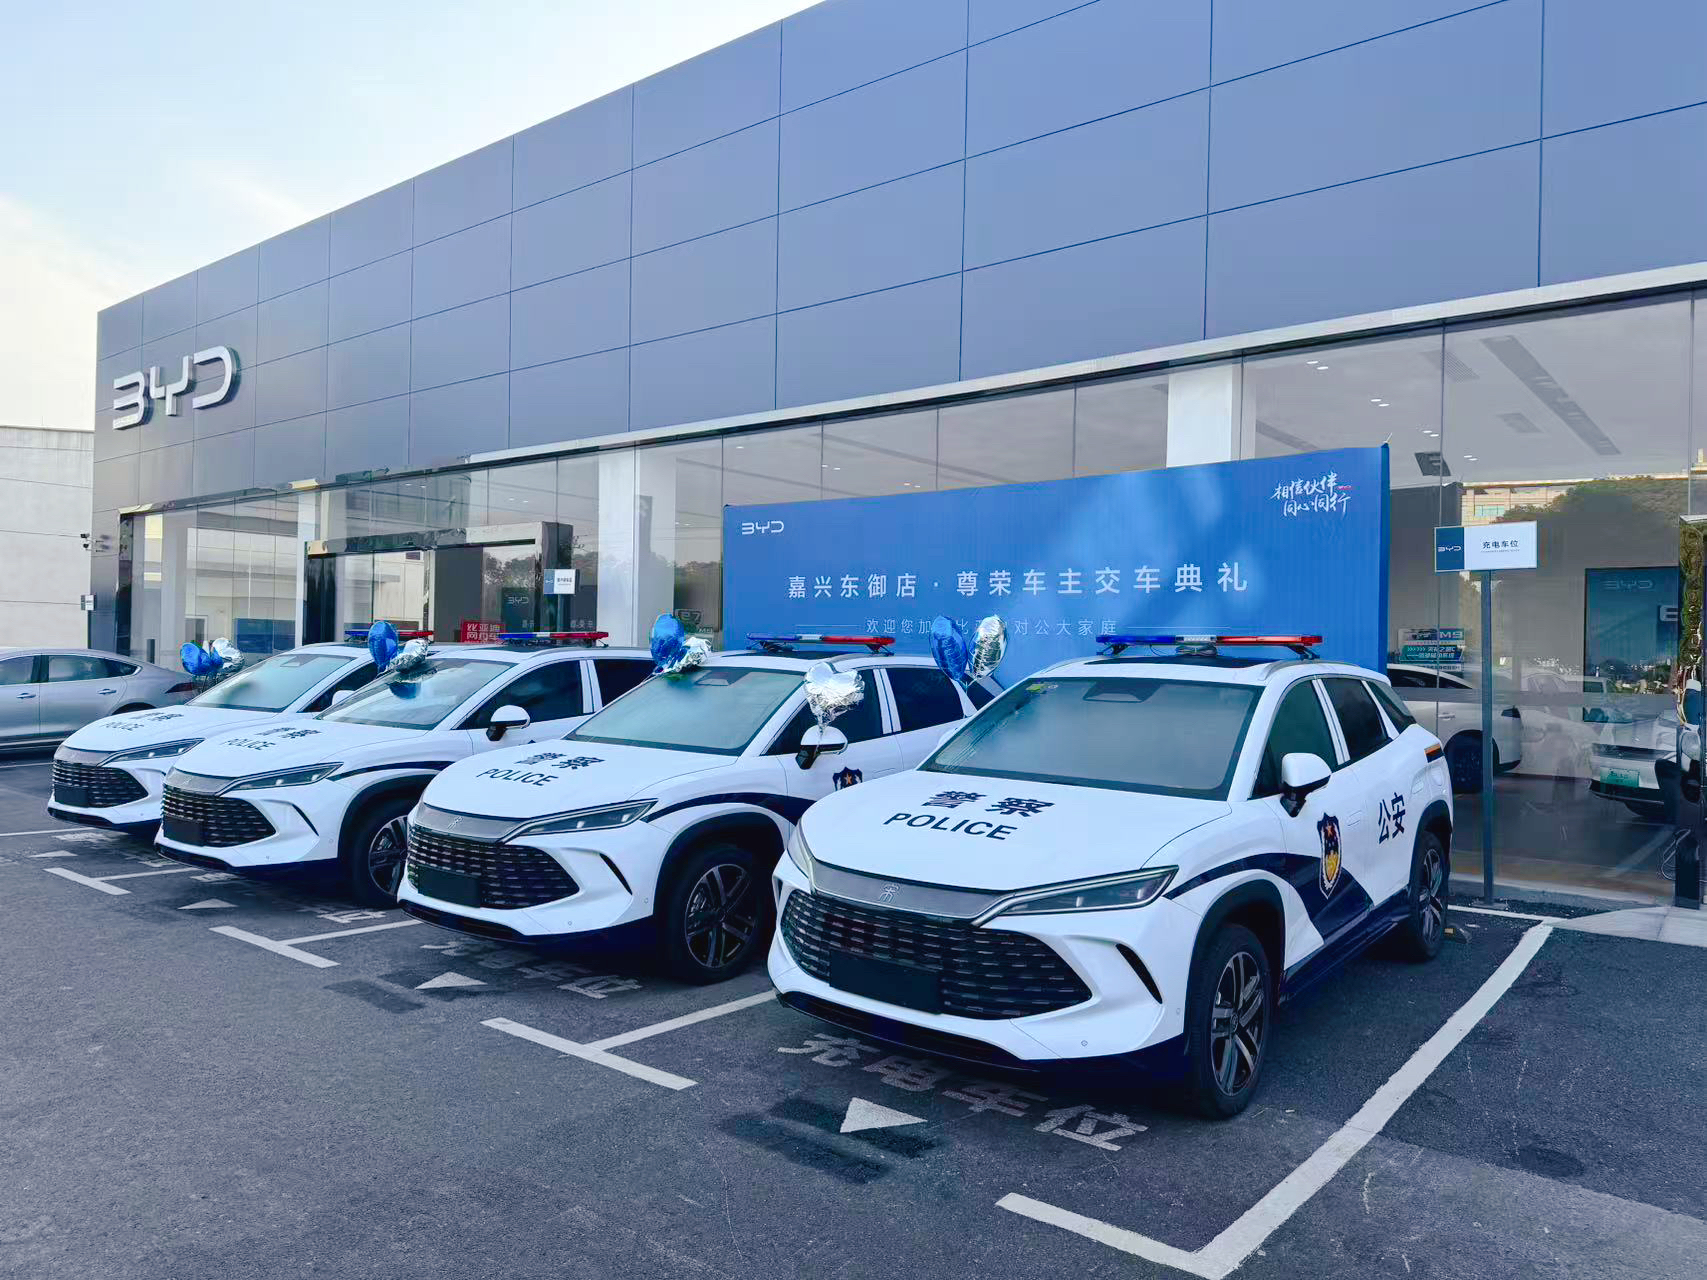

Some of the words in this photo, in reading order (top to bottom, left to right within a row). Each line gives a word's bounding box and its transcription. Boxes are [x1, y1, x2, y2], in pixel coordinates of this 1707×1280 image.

[112, 345, 239, 430] BYD
[1270, 471, 1338, 500] 相信伙伴
[1283, 493, 1351, 517] 同心同行
[741, 520, 785, 535] BYD
[1482, 540, 1519, 549] 充电车位
[475, 768, 559, 787] POLICE
[921, 790, 1056, 818] 警察
[882, 812, 1018, 841] POLICE
[1378, 792, 1406, 845] 公安
[777, 1032, 1150, 1152] 充电车位
